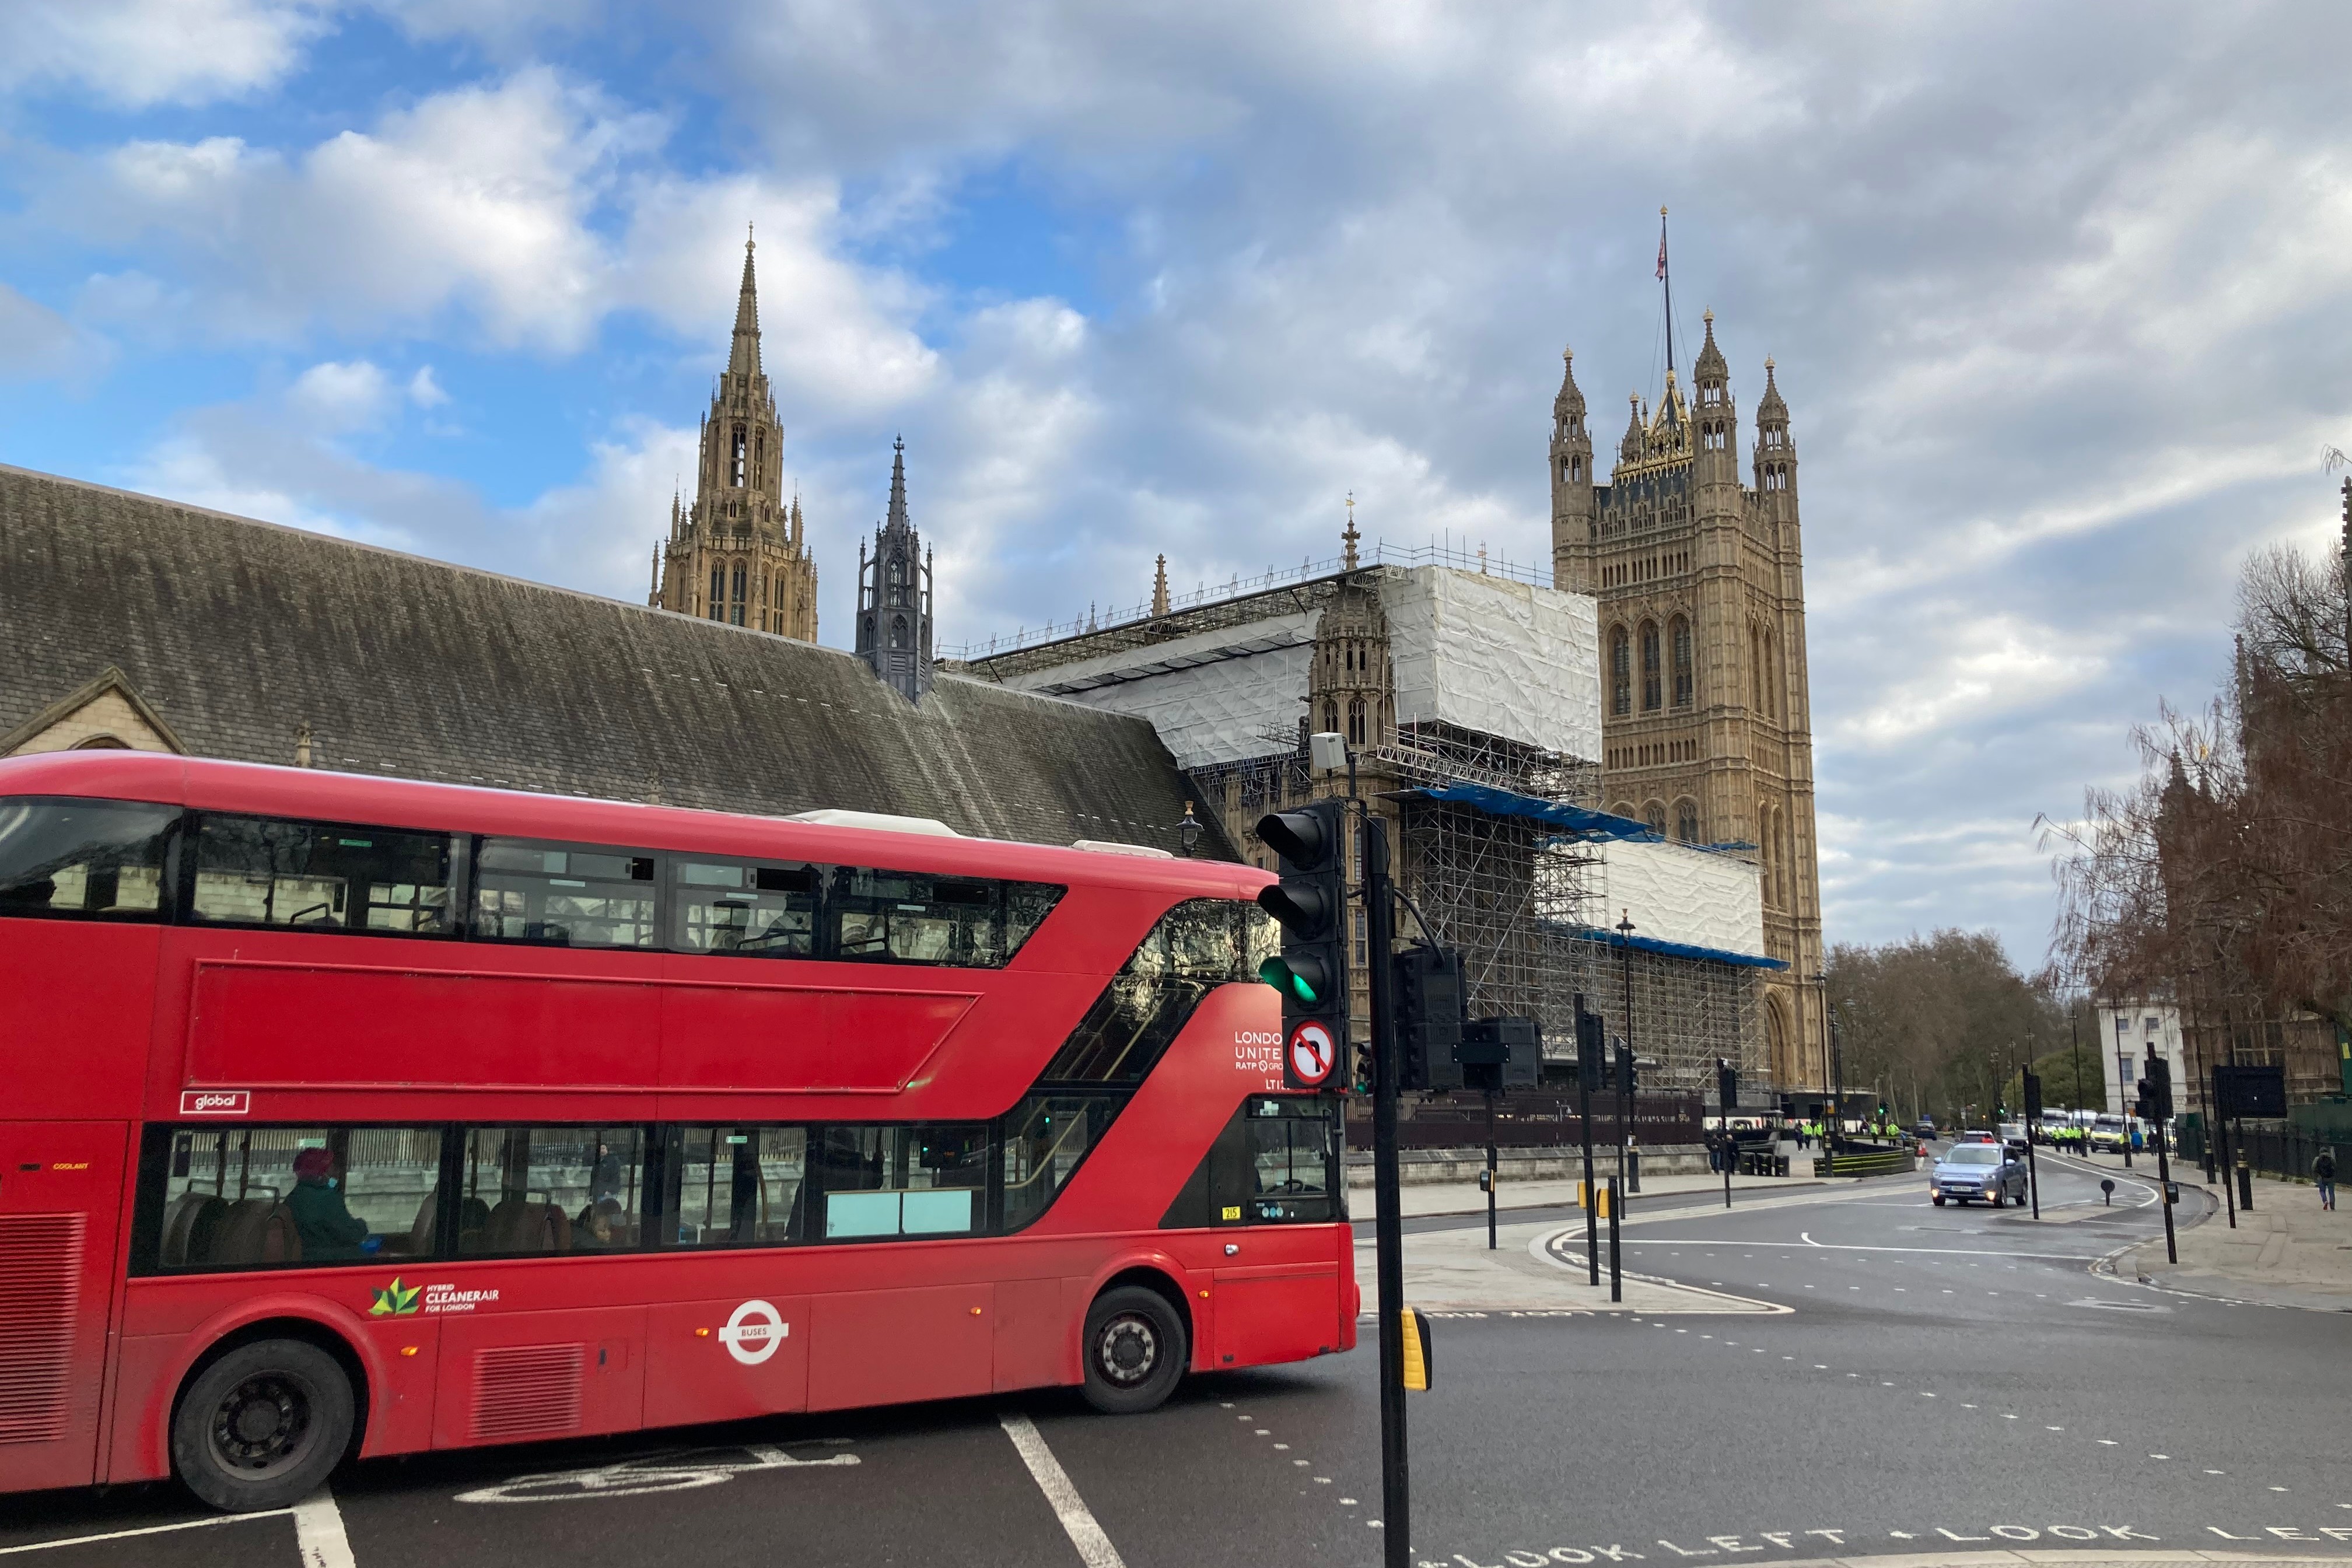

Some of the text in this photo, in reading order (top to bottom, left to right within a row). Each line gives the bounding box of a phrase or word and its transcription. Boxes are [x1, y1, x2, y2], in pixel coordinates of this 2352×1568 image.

[1234, 1031, 1282, 1045] LONDO
[1235, 1046, 1282, 1060] UNITE
[1236, 1062, 1257, 1070] RATP
[1265, 1078, 1290, 1090] LT12
[195, 1094, 236, 1110] global
[1226, 1208, 1237, 1218] 215
[426, 1283, 455, 1292] HYBRID
[425, 1303, 475, 1312] FOR LONDON
[741, 1327, 766, 1336] BUSES
[1453, 1525, 2352, 1568] LOOK LEFT LOOK LEF
